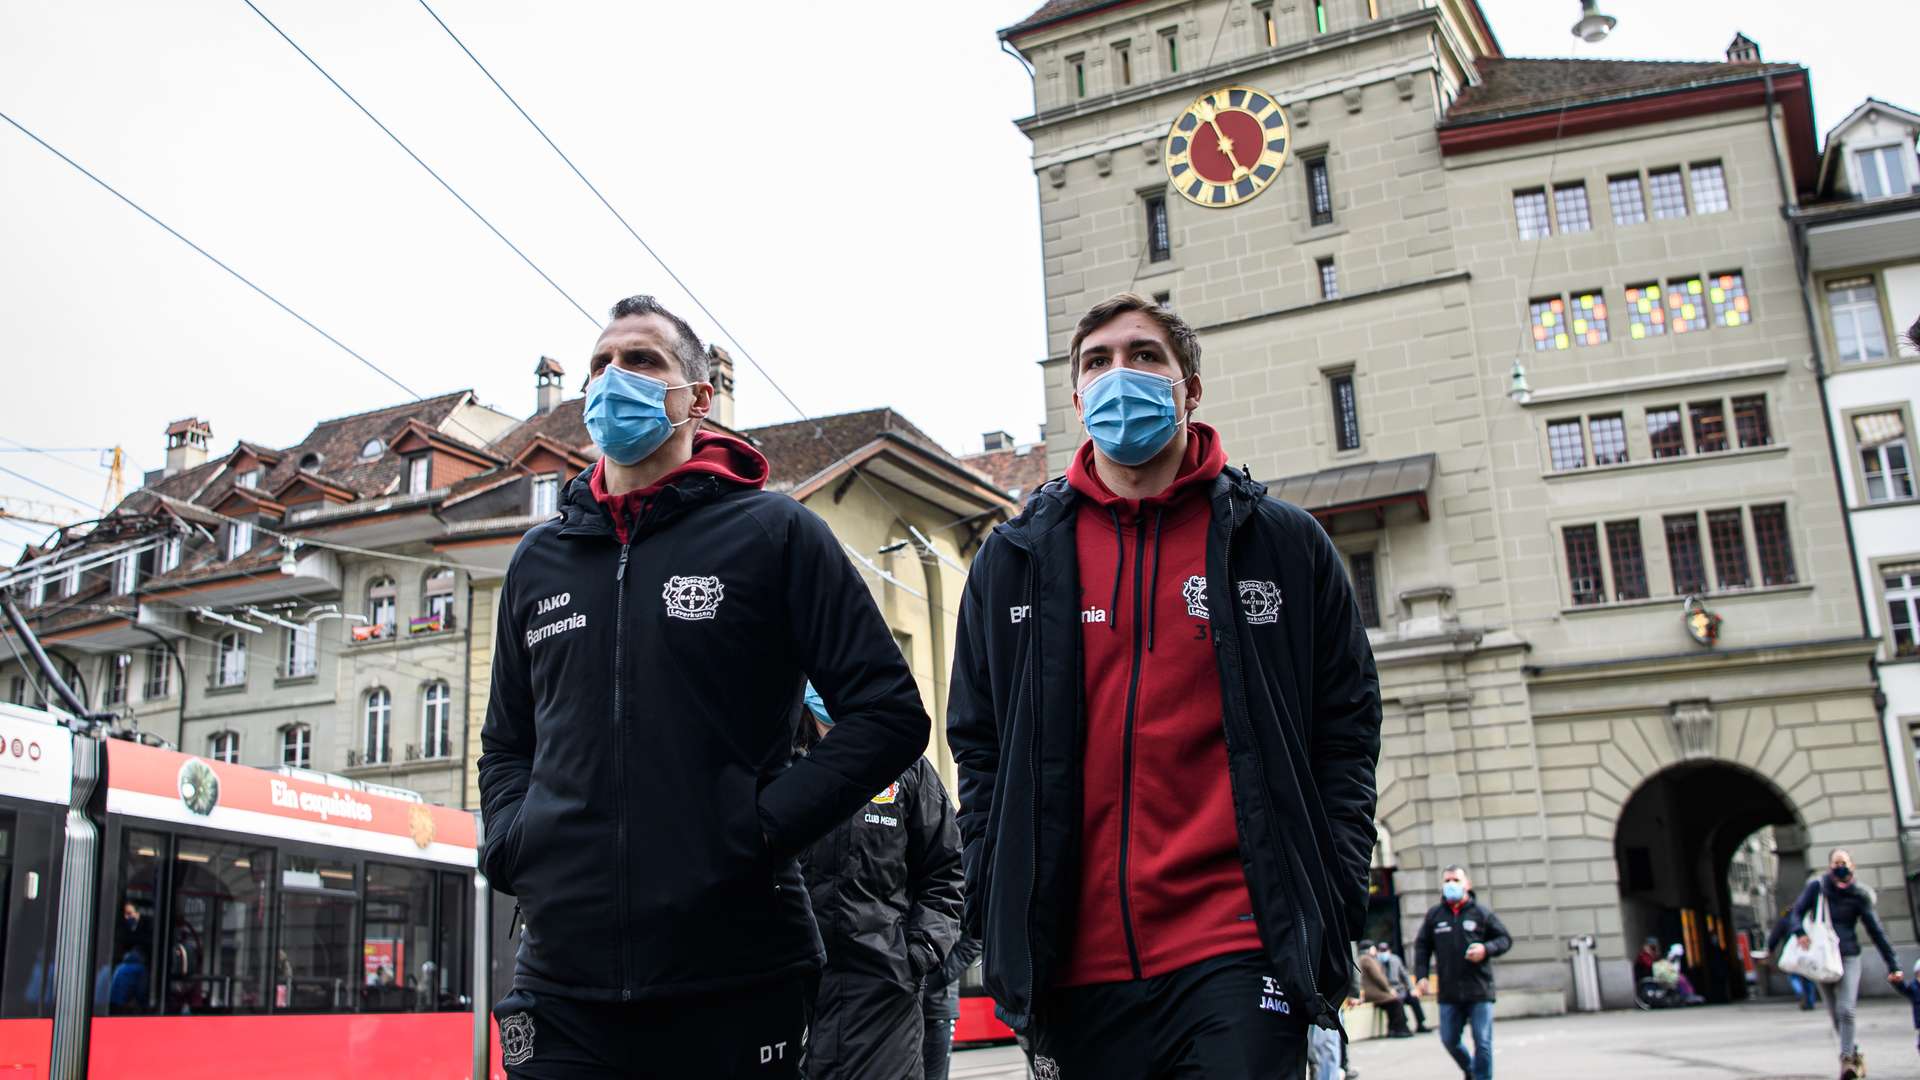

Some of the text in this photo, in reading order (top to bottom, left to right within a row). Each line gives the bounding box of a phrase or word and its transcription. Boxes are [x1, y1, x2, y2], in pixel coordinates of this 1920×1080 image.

[537, 592, 571, 615] JAKO
[670, 608, 712, 618] Leverkusen
[1081, 605, 1106, 624] nia
[527, 612, 587, 649] Barmenia
[270, 780, 373, 821] Ein exquisites
[864, 813, 879, 824] CLUB
[1260, 996, 1289, 1014] JAKO
